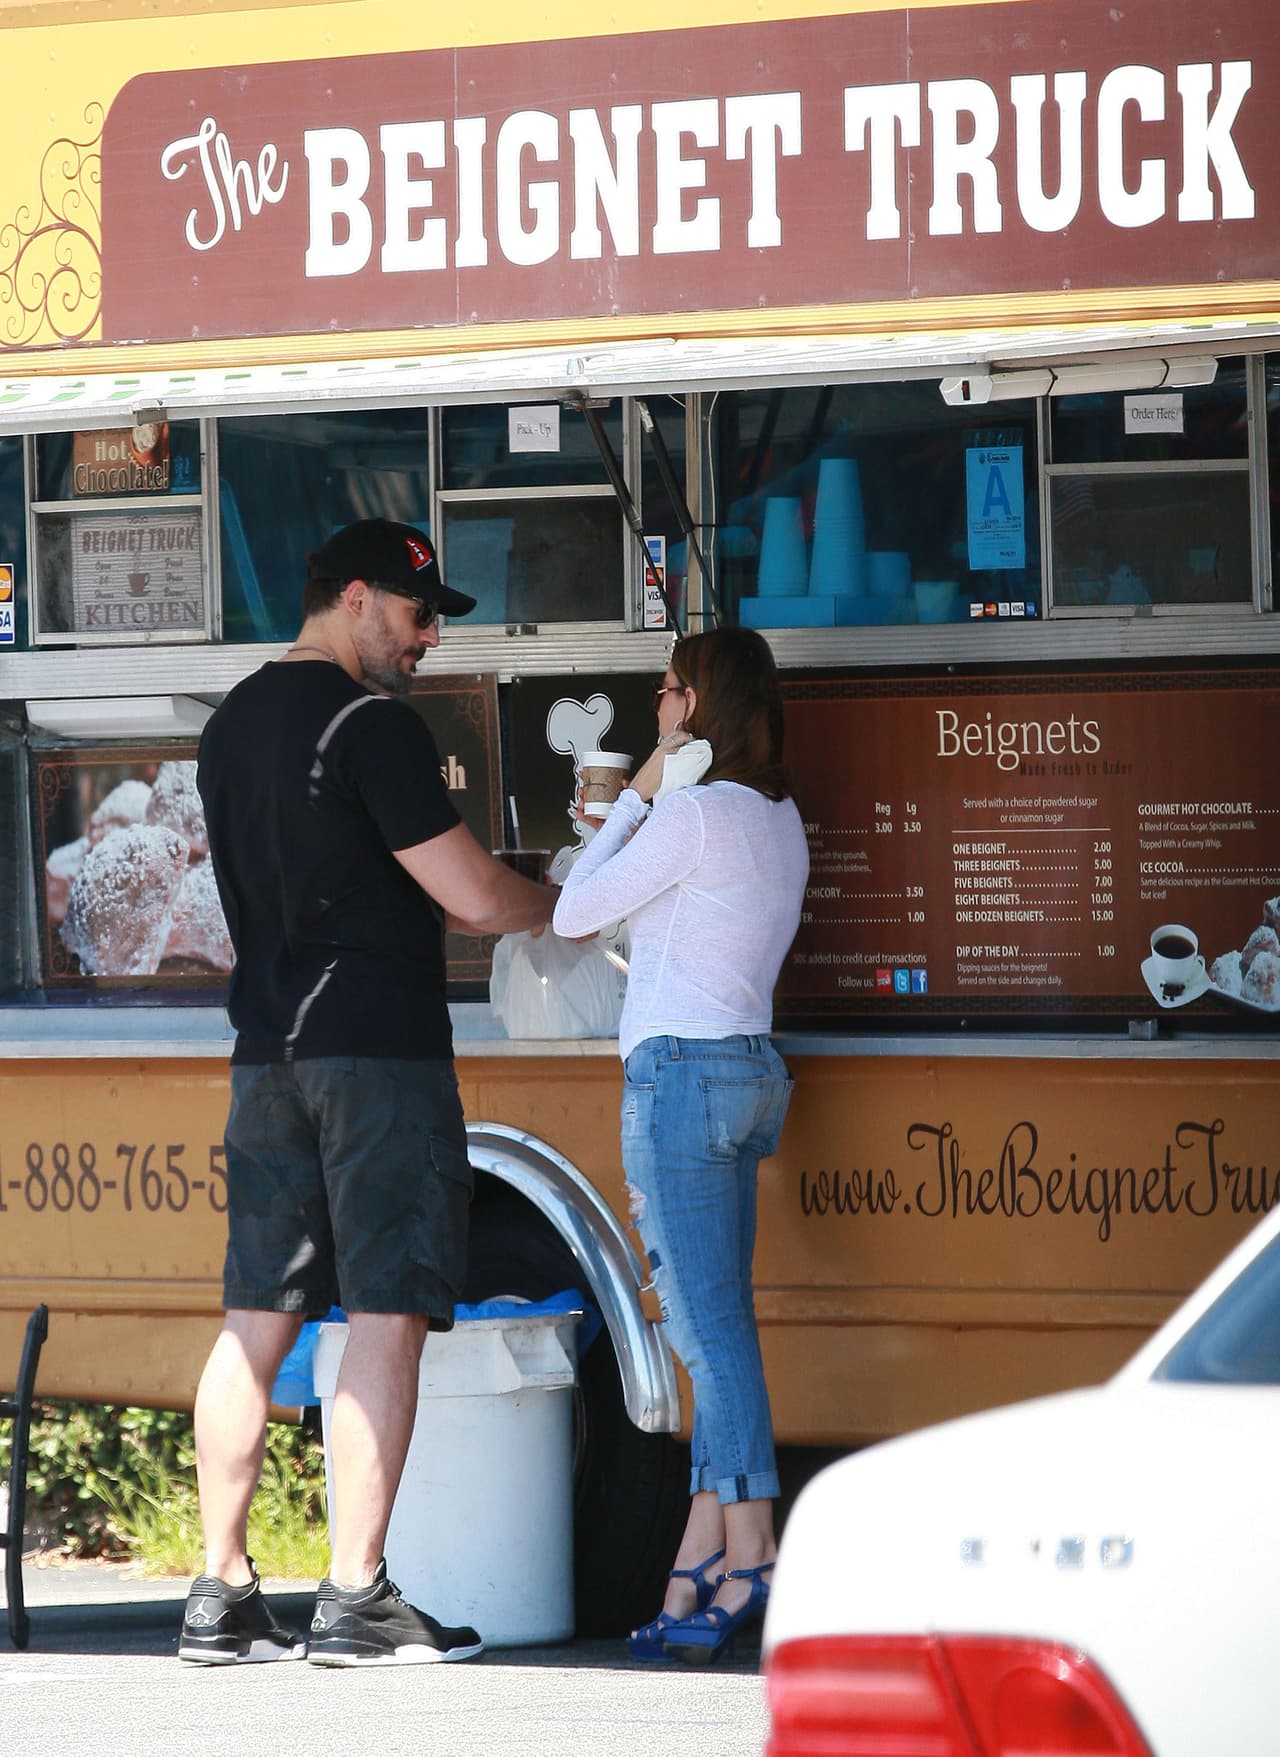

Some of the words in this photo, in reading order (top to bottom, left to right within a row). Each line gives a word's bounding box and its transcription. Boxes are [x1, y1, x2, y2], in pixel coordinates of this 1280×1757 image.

[161, 115, 289, 251] The
[304, 91, 802, 278] BEIGNET
[844, 60, 1255, 241] TRUCK
[1131, 407, 1155, 420] Order
[95, 440, 127, 461] Hot
[74, 459, 169, 493] Chocolate!
[982, 464, 1012, 517] A
[82, 528, 145, 552] BEIGNET
[148, 526, 195, 551] TRUCK
[86, 600, 199, 625] KITCHEN
[935, 709, 1101, 770] Beignets
[1087, 761, 1097, 776] to
[875, 802, 891, 815] Reg
[906, 801, 917, 815] Lg
[963, 797, 987, 808] Served
[988, 797, 1004, 808] with
[1010, 796, 1033, 807] choice
[1034, 796, 1041, 807] of
[1042, 796, 1077, 809] powdered
[1079, 797, 1098, 809] sugar
[1138, 803, 1180, 815] GOURMET
[1181, 803, 1199, 815] HOT
[1201, 802, 1252, 815] CHOCOLATE
[1000, 814, 1008, 823] or
[1009, 813, 1044, 823] cinnamon
[1045, 813, 1064, 825] sugar
[875, 822, 892, 833] 3.00
[904, 821, 921, 833] 3.50
[1144, 822, 1161, 832] Blend
[953, 843, 970, 854] ONE
[972, 843, 1006, 854] BEIGNET
[1093, 842, 1111, 853] 2.00
[1140, 839, 1161, 850] Topped
[1181, 839, 1204, 850] Creamy
[953, 860, 980, 872] THREE
[981, 859, 1020, 871] BEIGNETS
[1094, 859, 1112, 870] 5.00
[1140, 862, 1153, 873] ICE
[1154, 861, 1185, 873] COCOA
[954, 877, 972, 888] FIVE
[973, 876, 1013, 888] BEIGNETS
[1095, 876, 1112, 887] 7.00
[1140, 877, 1157, 886] Same
[1158, 876, 1184, 887] delicious
[806, 887, 841, 899] CHICORY
[906, 886, 924, 898] 3.50
[1140, 889, 1152, 899] but
[955, 894, 980, 906] EIGHT
[981, 894, 1020, 905] BEIGNETS
[1091, 893, 1113, 904] 10.00
[907, 911, 925, 923] 1.00
[956, 911, 973, 922] ONE
[974, 911, 1003, 922] DOZEN
[1004, 910, 1044, 922] BEIGNETS
[1092, 910, 1113, 921] 15.00
[956, 946, 970, 957] DIP
[972, 946, 983, 957] OF
[984, 946, 1001, 957] THE
[1002, 946, 1019, 957] DAY
[1097, 945, 1115, 956] 1.00
[808, 953, 832, 964] added
[833, 952, 841, 963] to
[842, 952, 863, 963] credit
[864, 952, 880, 963] card
[882, 952, 927, 963] transactions
[957, 962, 980, 974] Dipping
[981, 963, 1000, 972] sauces
[1001, 963, 1009, 972] for
[1010, 963, 1020, 972] the
[838, 976, 862, 988] Follow
[957, 976, 977, 985] Served
[987, 976, 997, 985] the
[1023, 976, 1046, 986] changes
